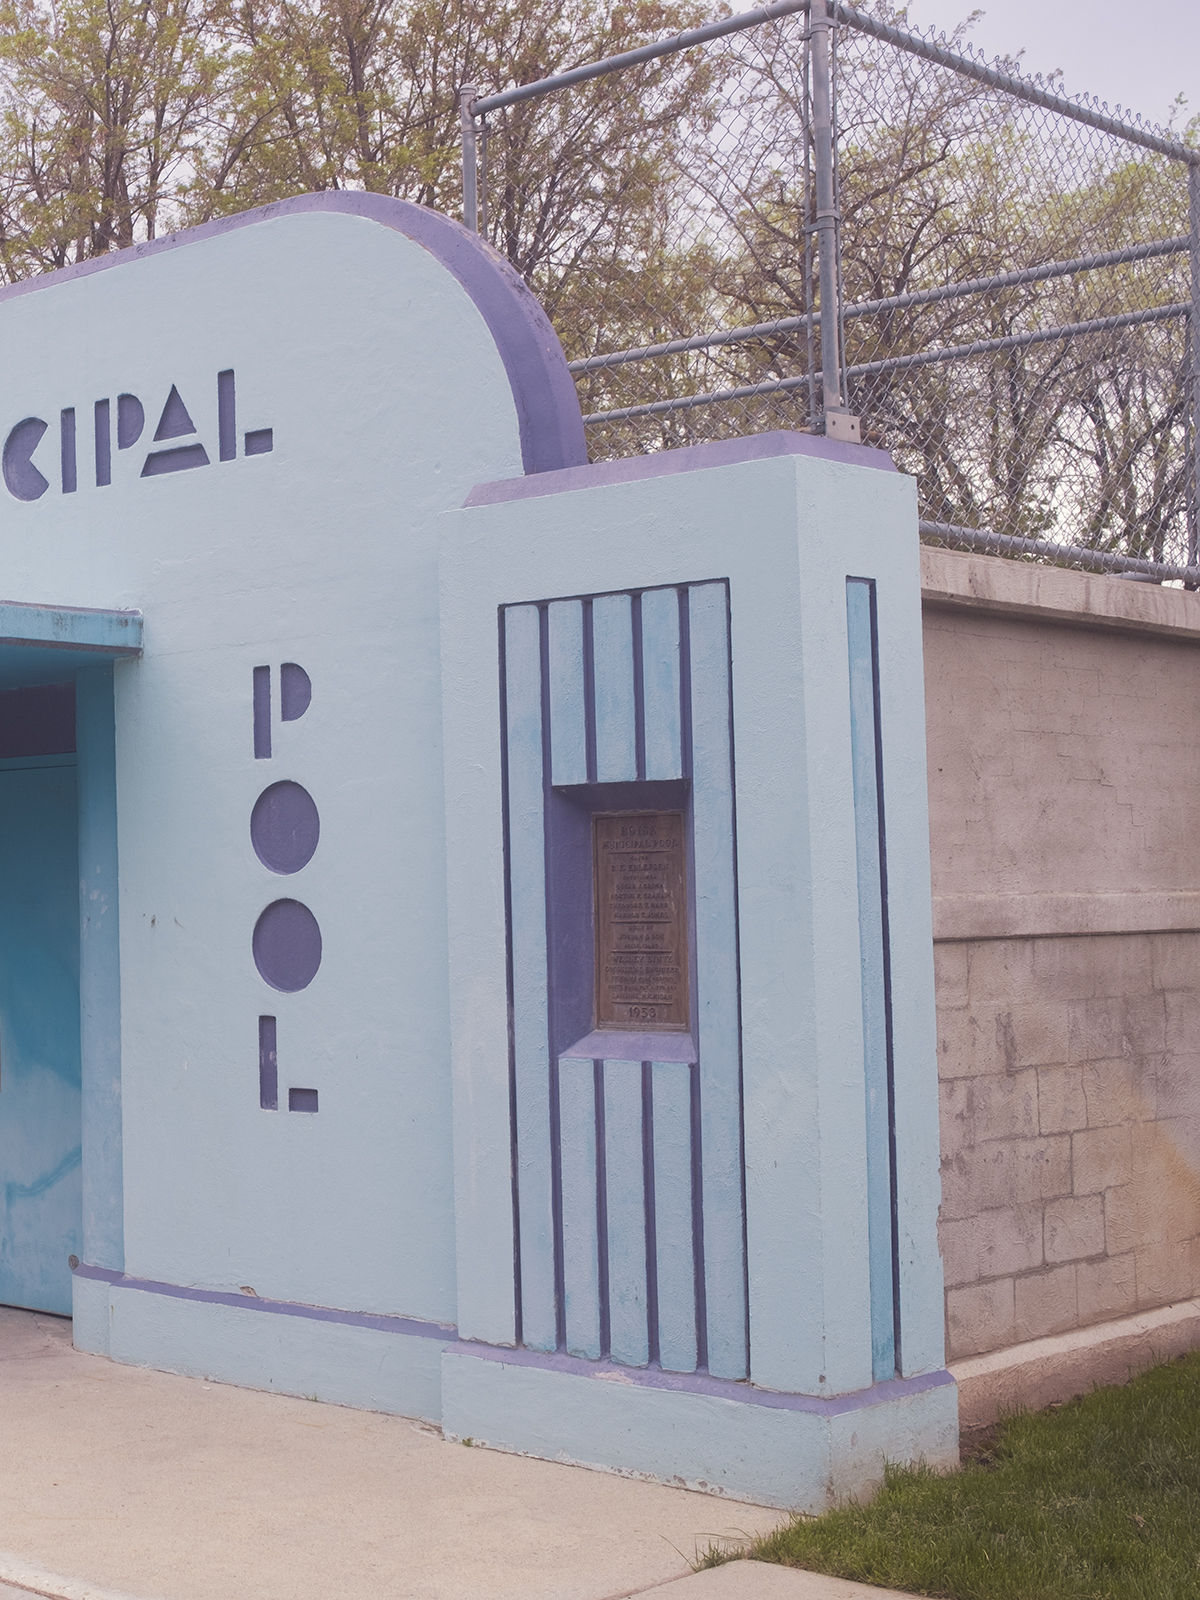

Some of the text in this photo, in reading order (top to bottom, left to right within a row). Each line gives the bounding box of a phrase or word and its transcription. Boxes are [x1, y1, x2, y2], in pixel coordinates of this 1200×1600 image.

[620, 825, 657, 837] BOISE
[602, 839, 678, 850] MUNICIPAL POOL
[250, 662, 322, 1113] POOL
[629, 1007, 657, 1019] 1953
